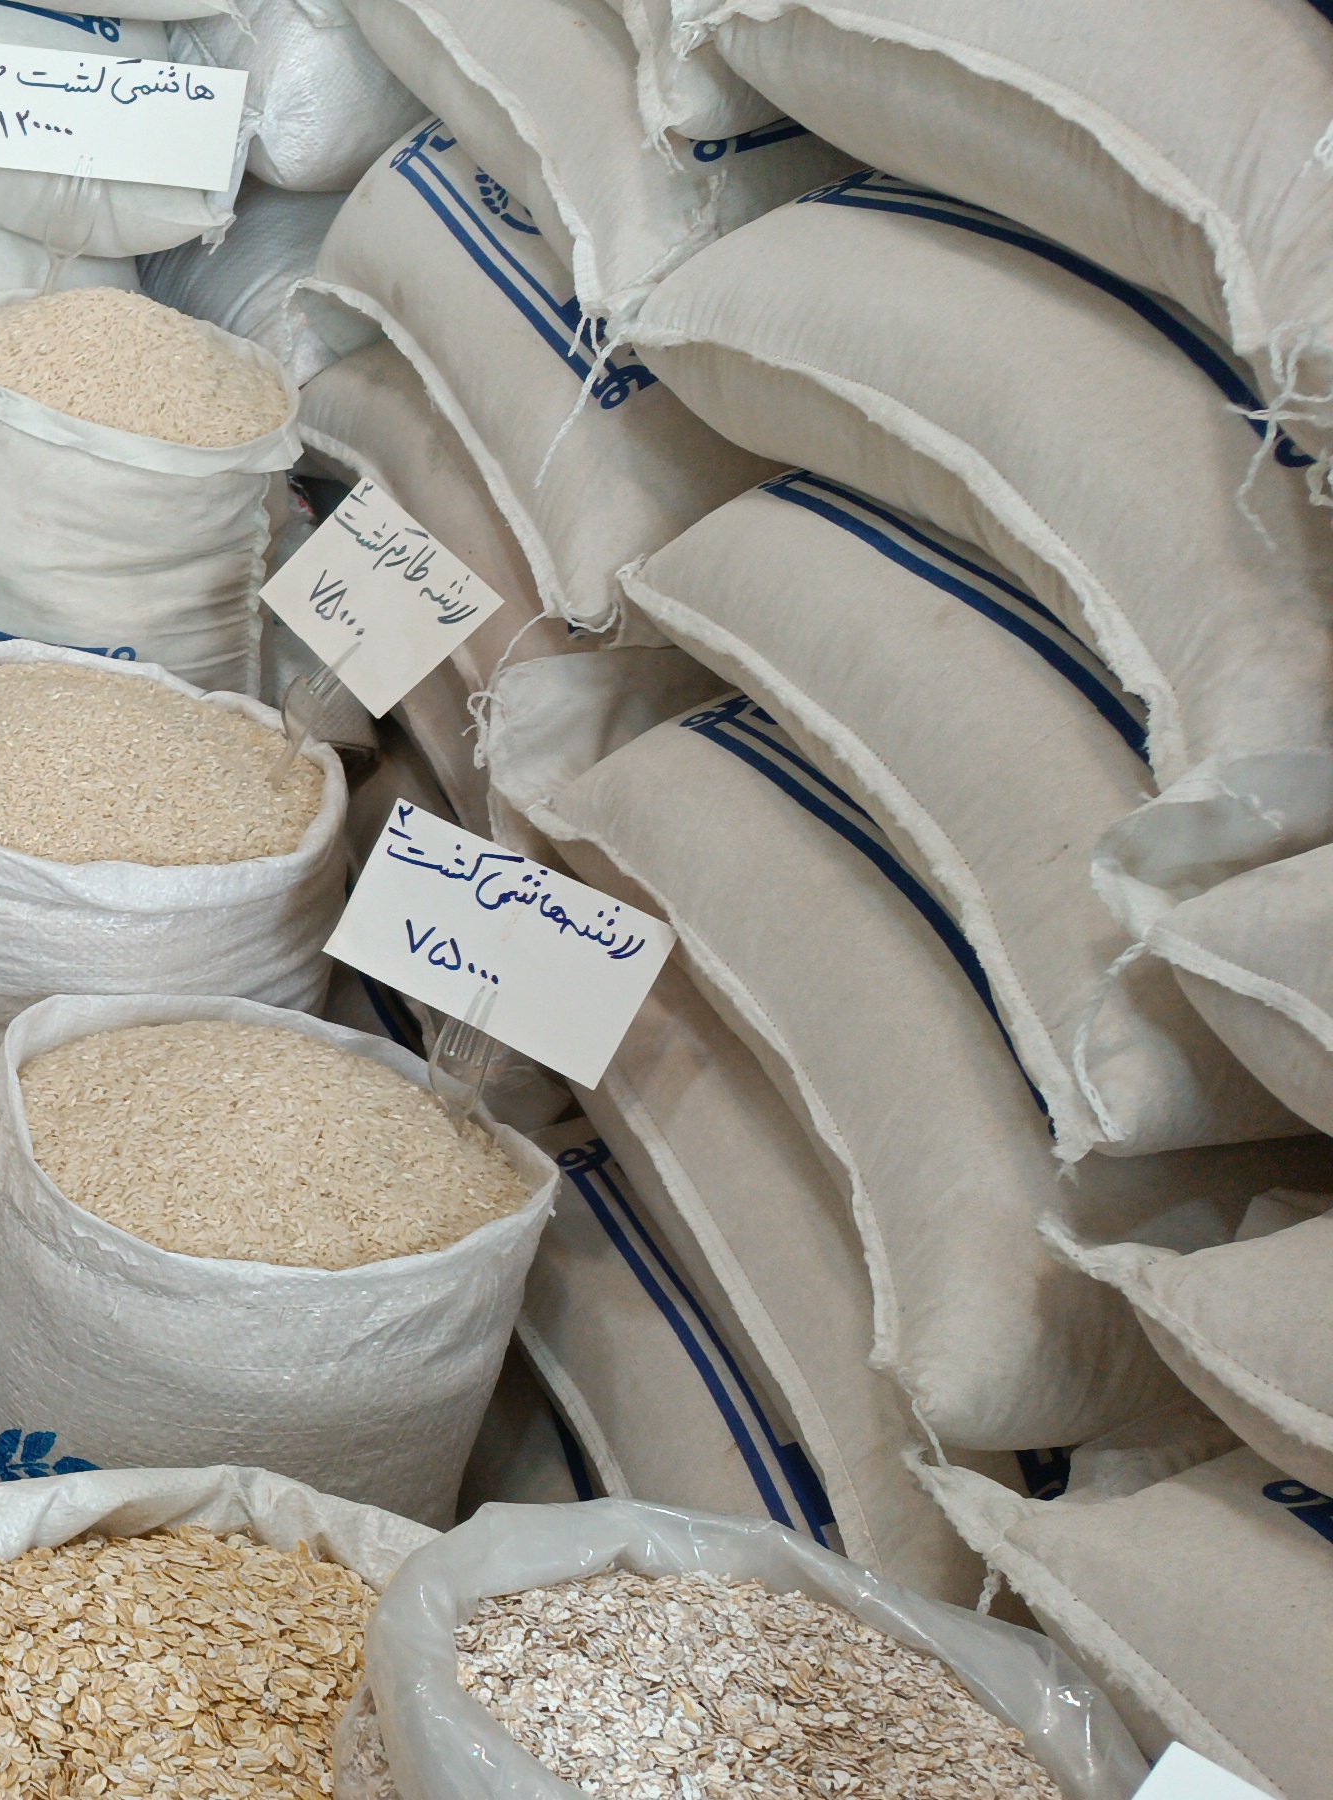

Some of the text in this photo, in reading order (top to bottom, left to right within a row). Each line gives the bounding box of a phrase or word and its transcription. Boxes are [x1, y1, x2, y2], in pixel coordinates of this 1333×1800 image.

[111, 66, 214, 104] هاشمی
[310, 570, 363, 635] ۷۵۰۰۰
[419, 574, 479, 624] لاشه
[386, 843, 524, 881] کشت
[475, 869, 567, 922] هاشمی
[406, 919, 498, 984] ۷۵۰۰۰
[559, 905, 646, 959] لاشه
